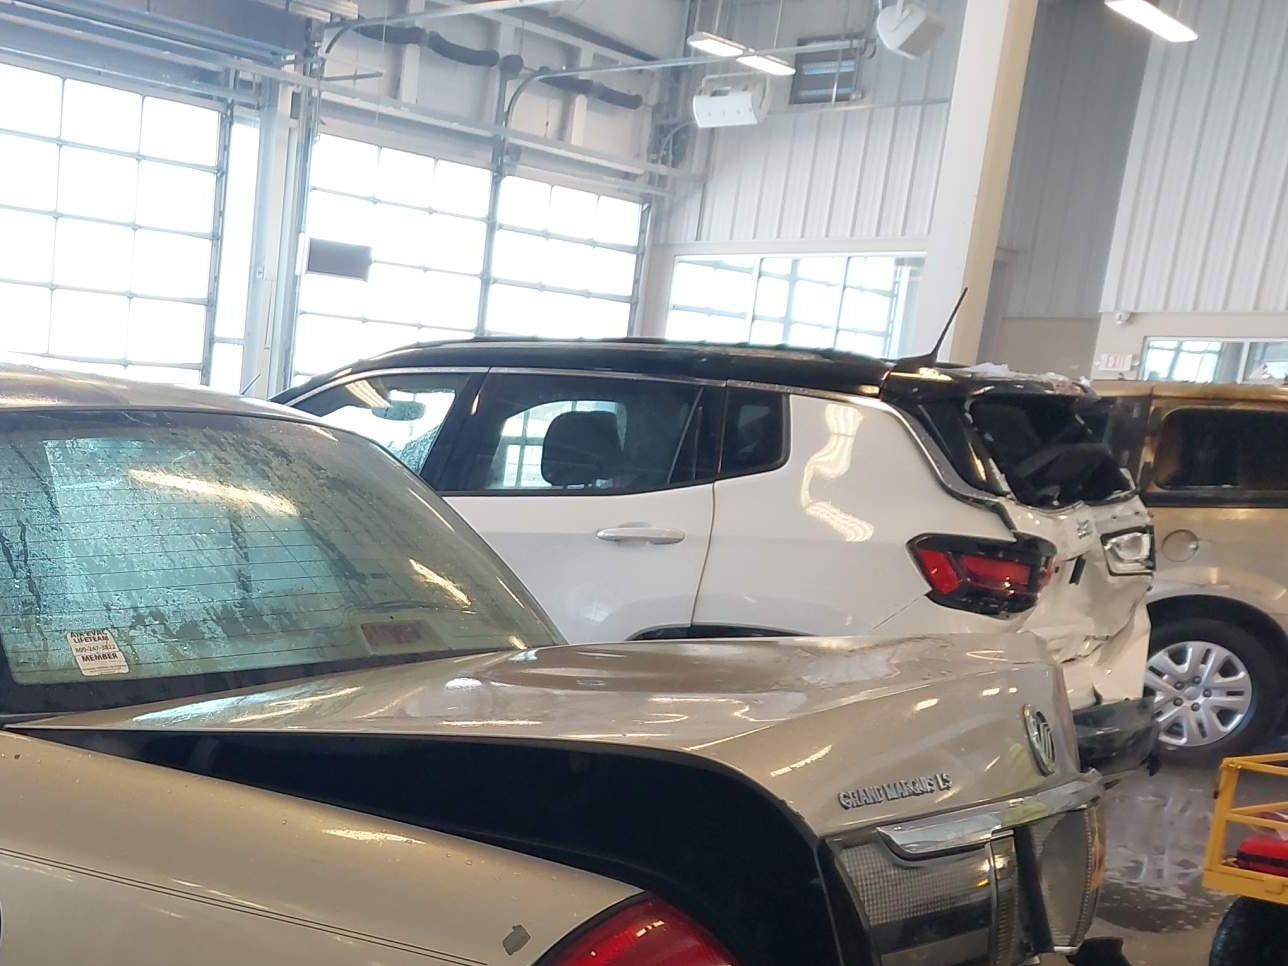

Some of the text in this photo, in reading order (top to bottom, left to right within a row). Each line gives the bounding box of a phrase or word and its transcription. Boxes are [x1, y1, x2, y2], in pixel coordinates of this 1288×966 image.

[73, 635, 109, 643] LIFETEAM
[82, 653, 118, 662] MEMBER
[838, 785, 886, 809] GRAND
[935, 772, 953, 791] LS
